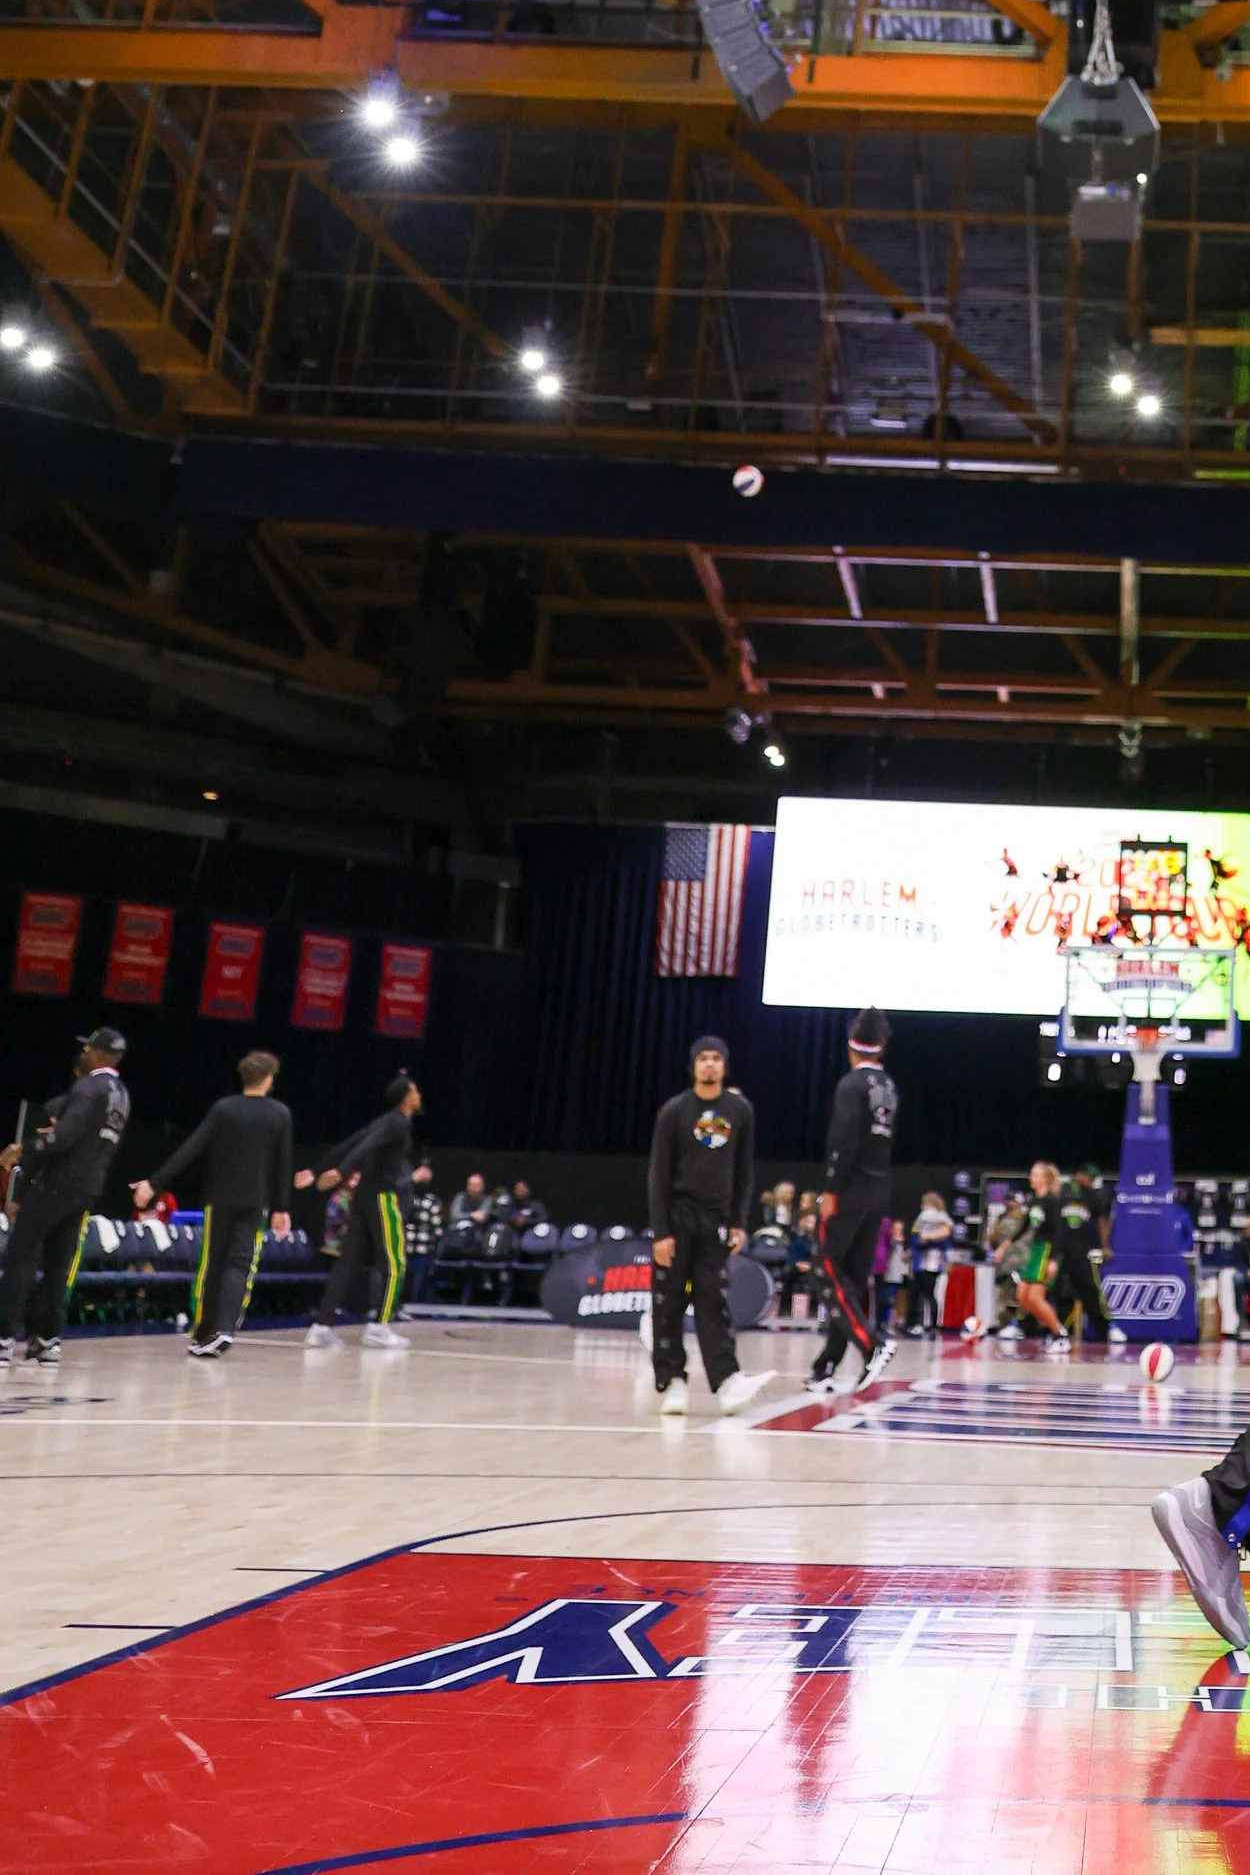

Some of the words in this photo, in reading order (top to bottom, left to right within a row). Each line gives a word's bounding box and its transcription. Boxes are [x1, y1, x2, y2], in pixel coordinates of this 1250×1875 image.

[803, 879, 917, 912] HARLEM
[602, 1264, 653, 1293] HAR
[1103, 1277, 1183, 1316] UIC
